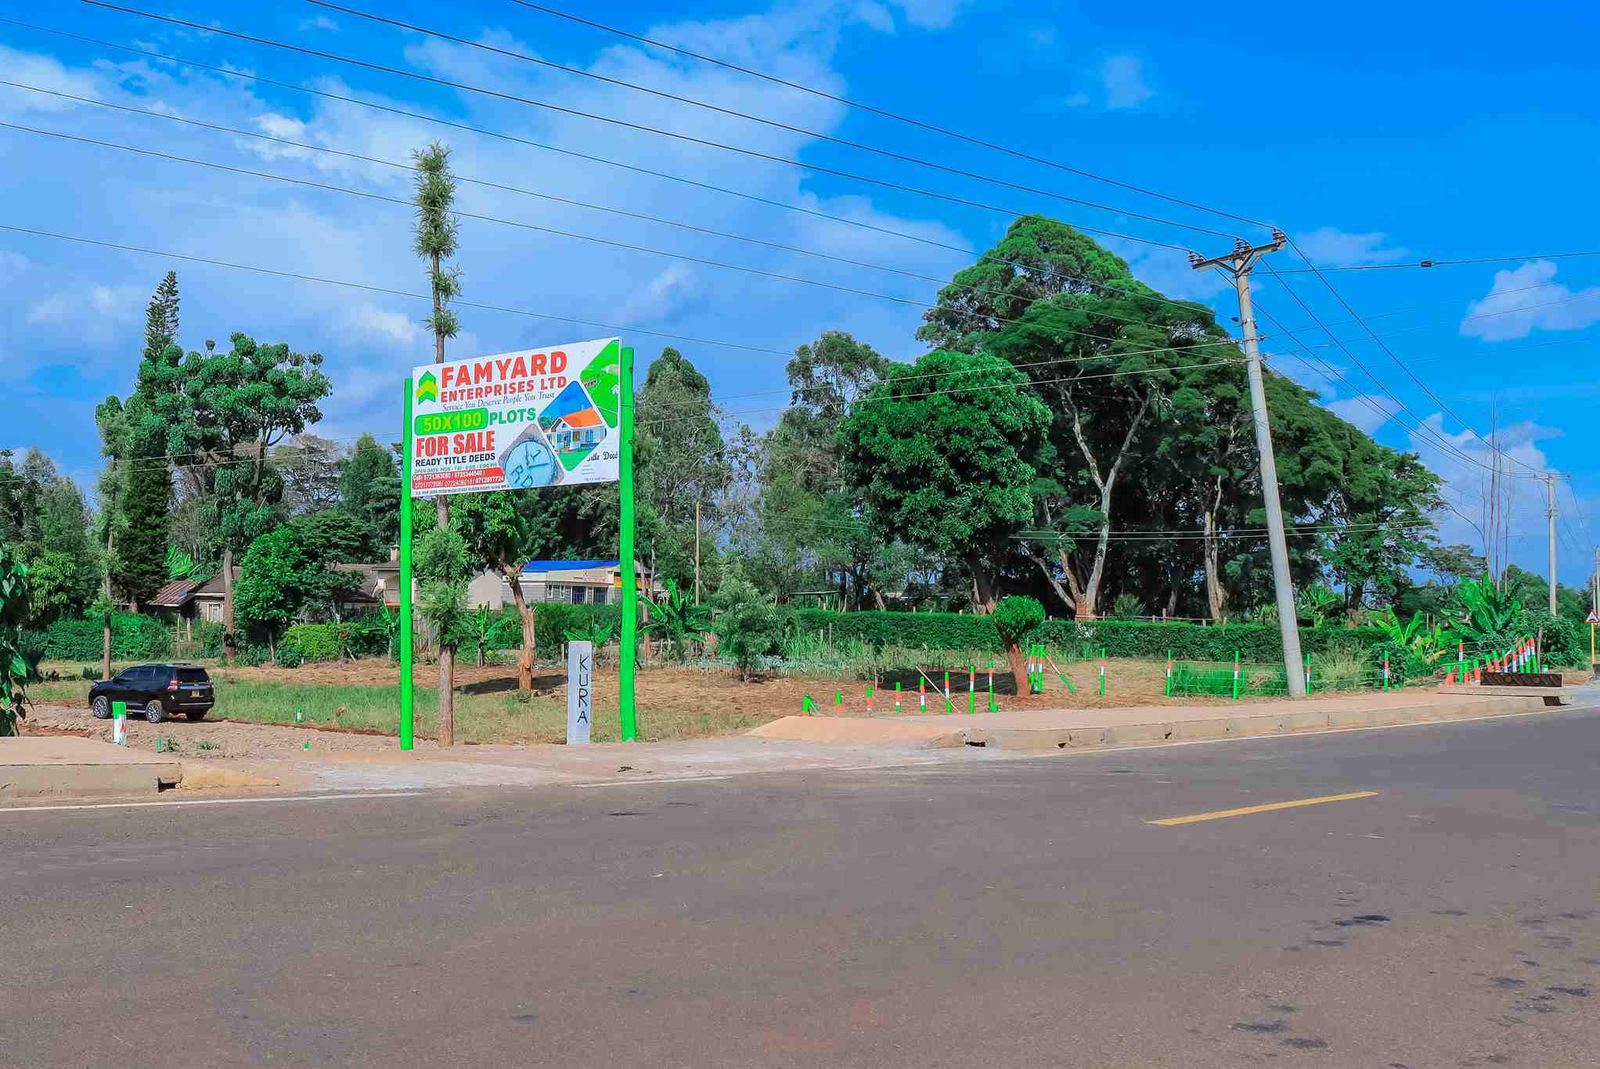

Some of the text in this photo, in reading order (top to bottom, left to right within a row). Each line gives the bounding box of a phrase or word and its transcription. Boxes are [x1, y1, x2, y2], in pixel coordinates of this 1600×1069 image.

[441, 351, 568, 389] FAMYARD
[440, 379, 535, 403] ENTERPRISES
[540, 376, 567, 391] LTD
[442, 391, 555, 411] Service You Deserve People You Trust
[423, 407, 537, 432] 50X100 PLOTS
[416, 430, 496, 458] FOR SALE
[415, 452, 496, 467] READY TITLE DEEDS
[576, 653, 590, 724] KURA
